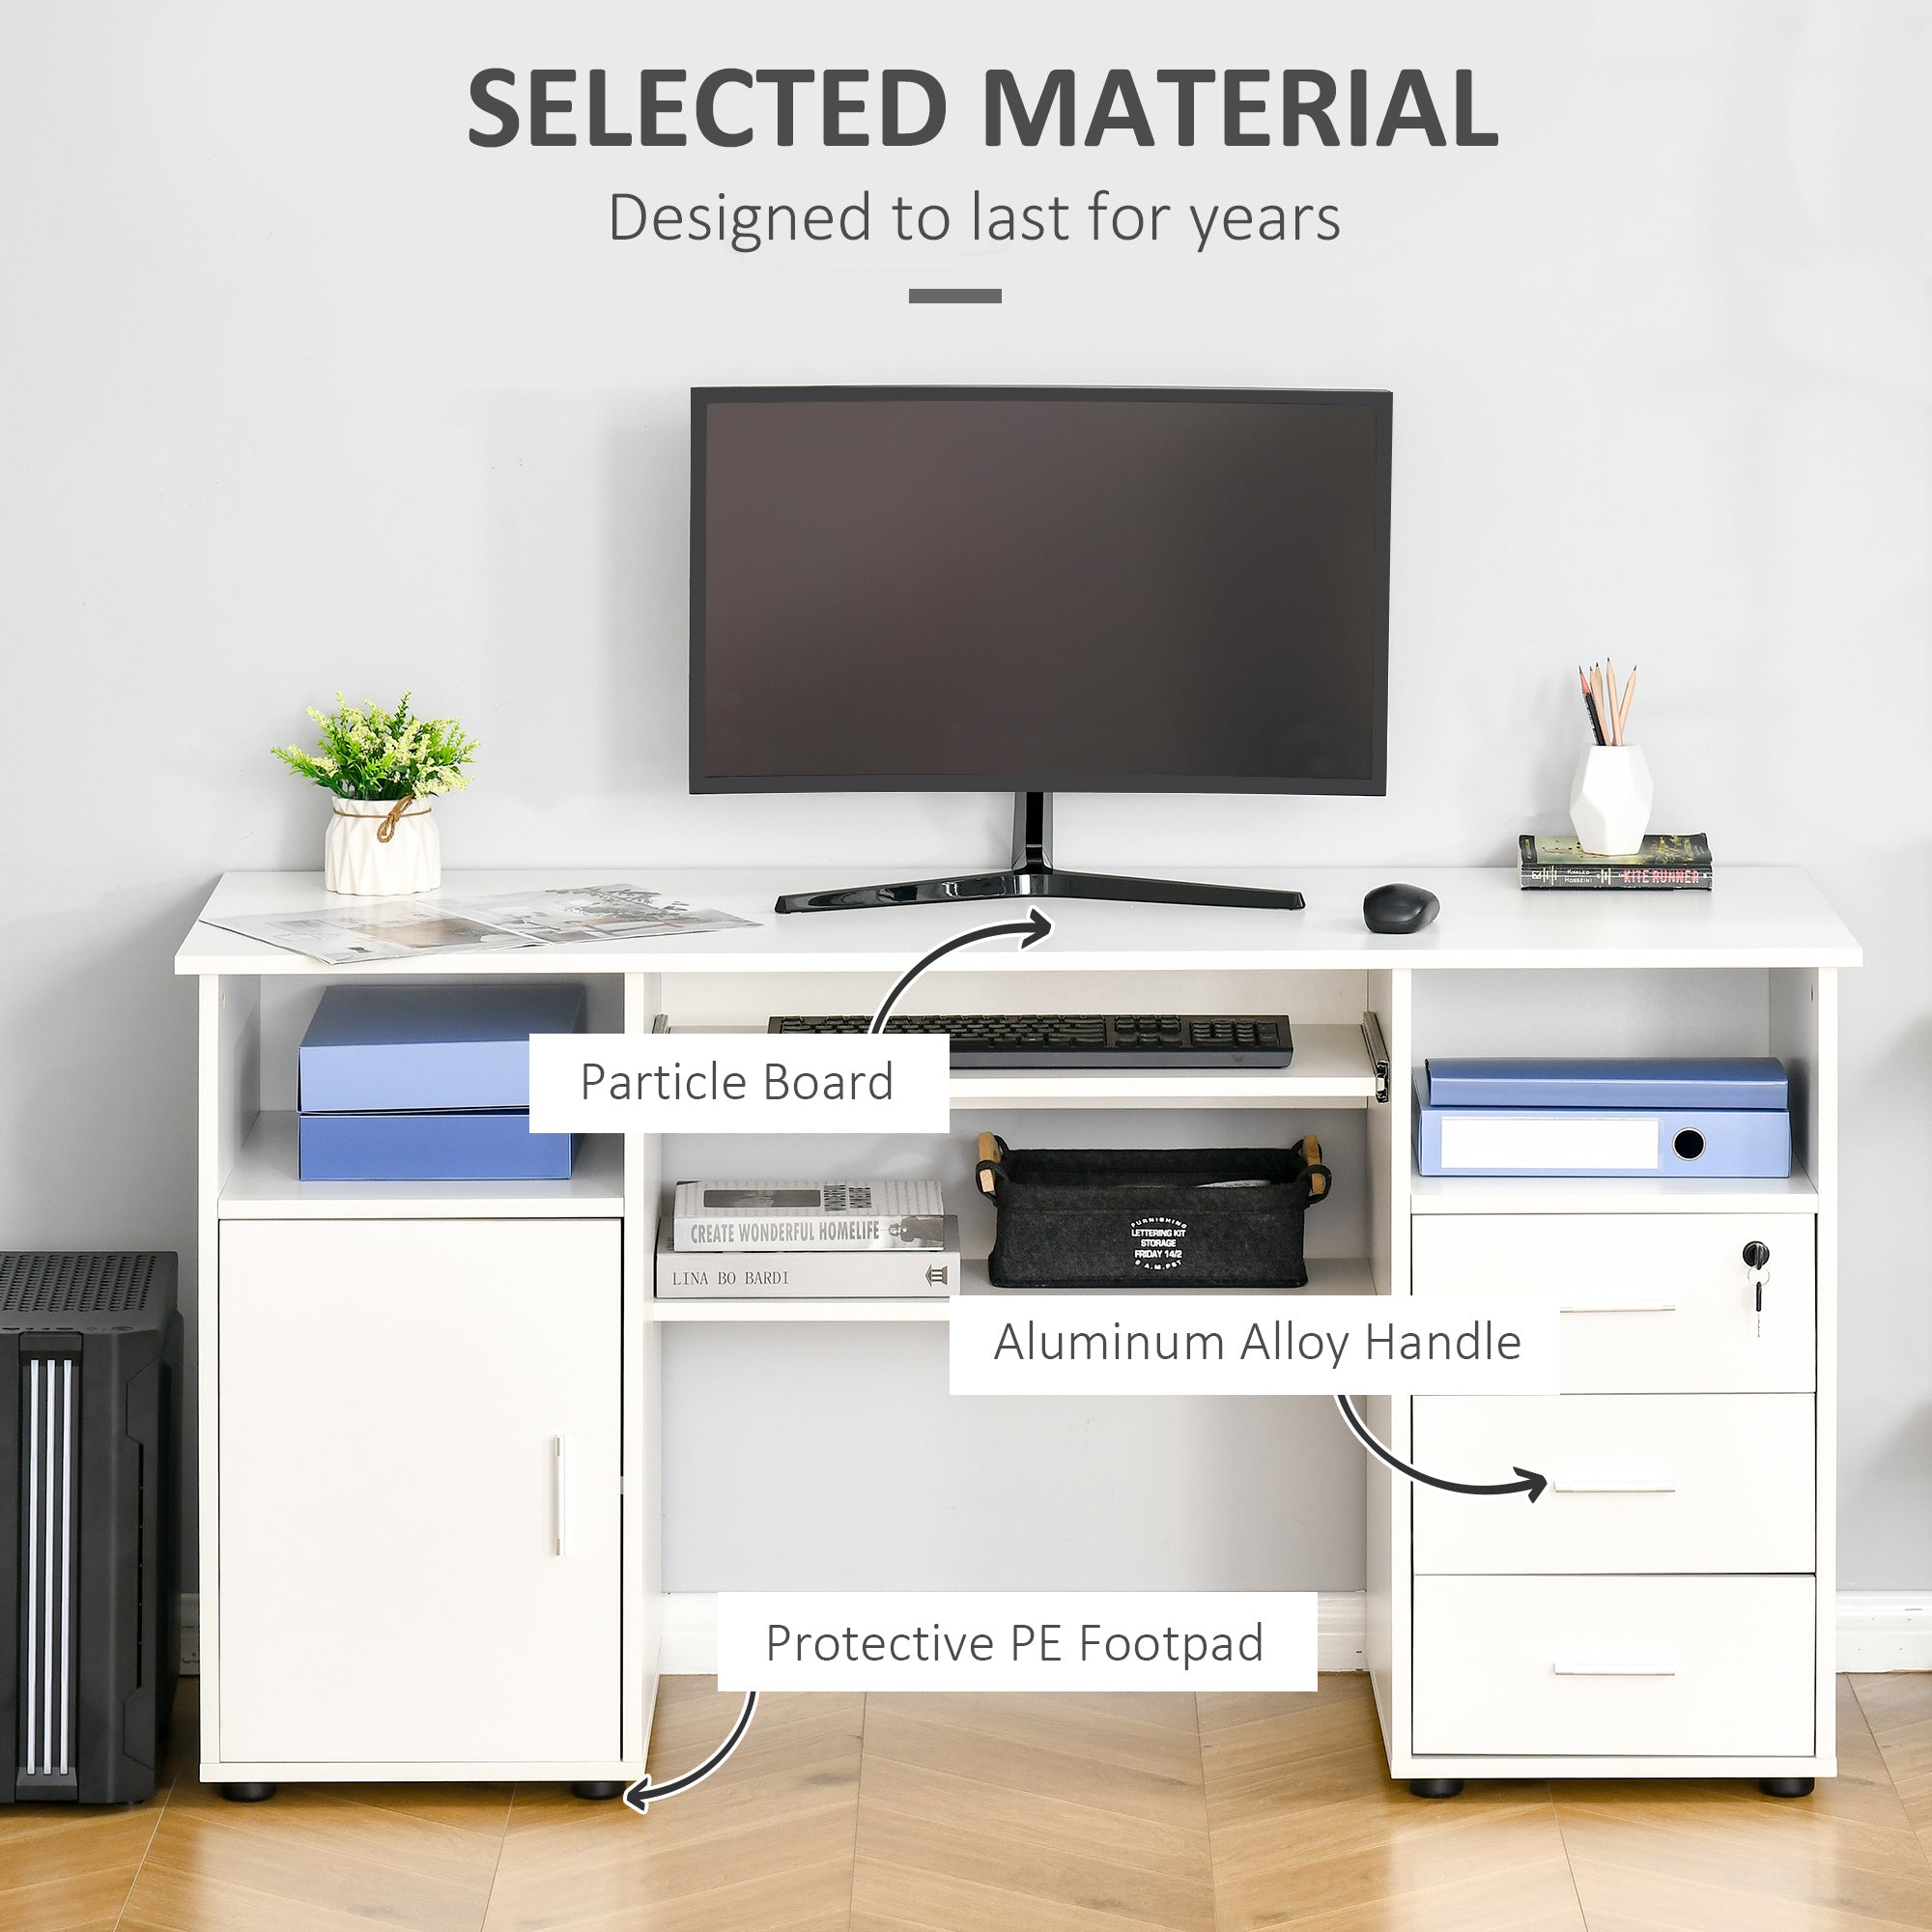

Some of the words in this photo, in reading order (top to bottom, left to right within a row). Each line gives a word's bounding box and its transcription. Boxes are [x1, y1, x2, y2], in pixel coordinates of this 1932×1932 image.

[1623, 868, 1649, 884] KITE
[1652, 868, 1699, 884] RUNNER
[691, 1223, 735, 1244] CREATE
[738, 1222, 815, 1243] WONDERFUL
[819, 1220, 880, 1241] HOMELIFE
[1131, 1229, 1173, 1237] LETTERING
[1174, 1229, 1186, 1237] KIT
[1141, 1238, 1177, 1248] STORAGE
[1134, 1249, 1163, 1259] FRIDAY
[1164, 1249, 1182, 1259] 14/2
[672, 1271, 709, 1286] LINA
[718, 1271, 736, 1285] BO
[745, 1270, 788, 1285] BARDI
